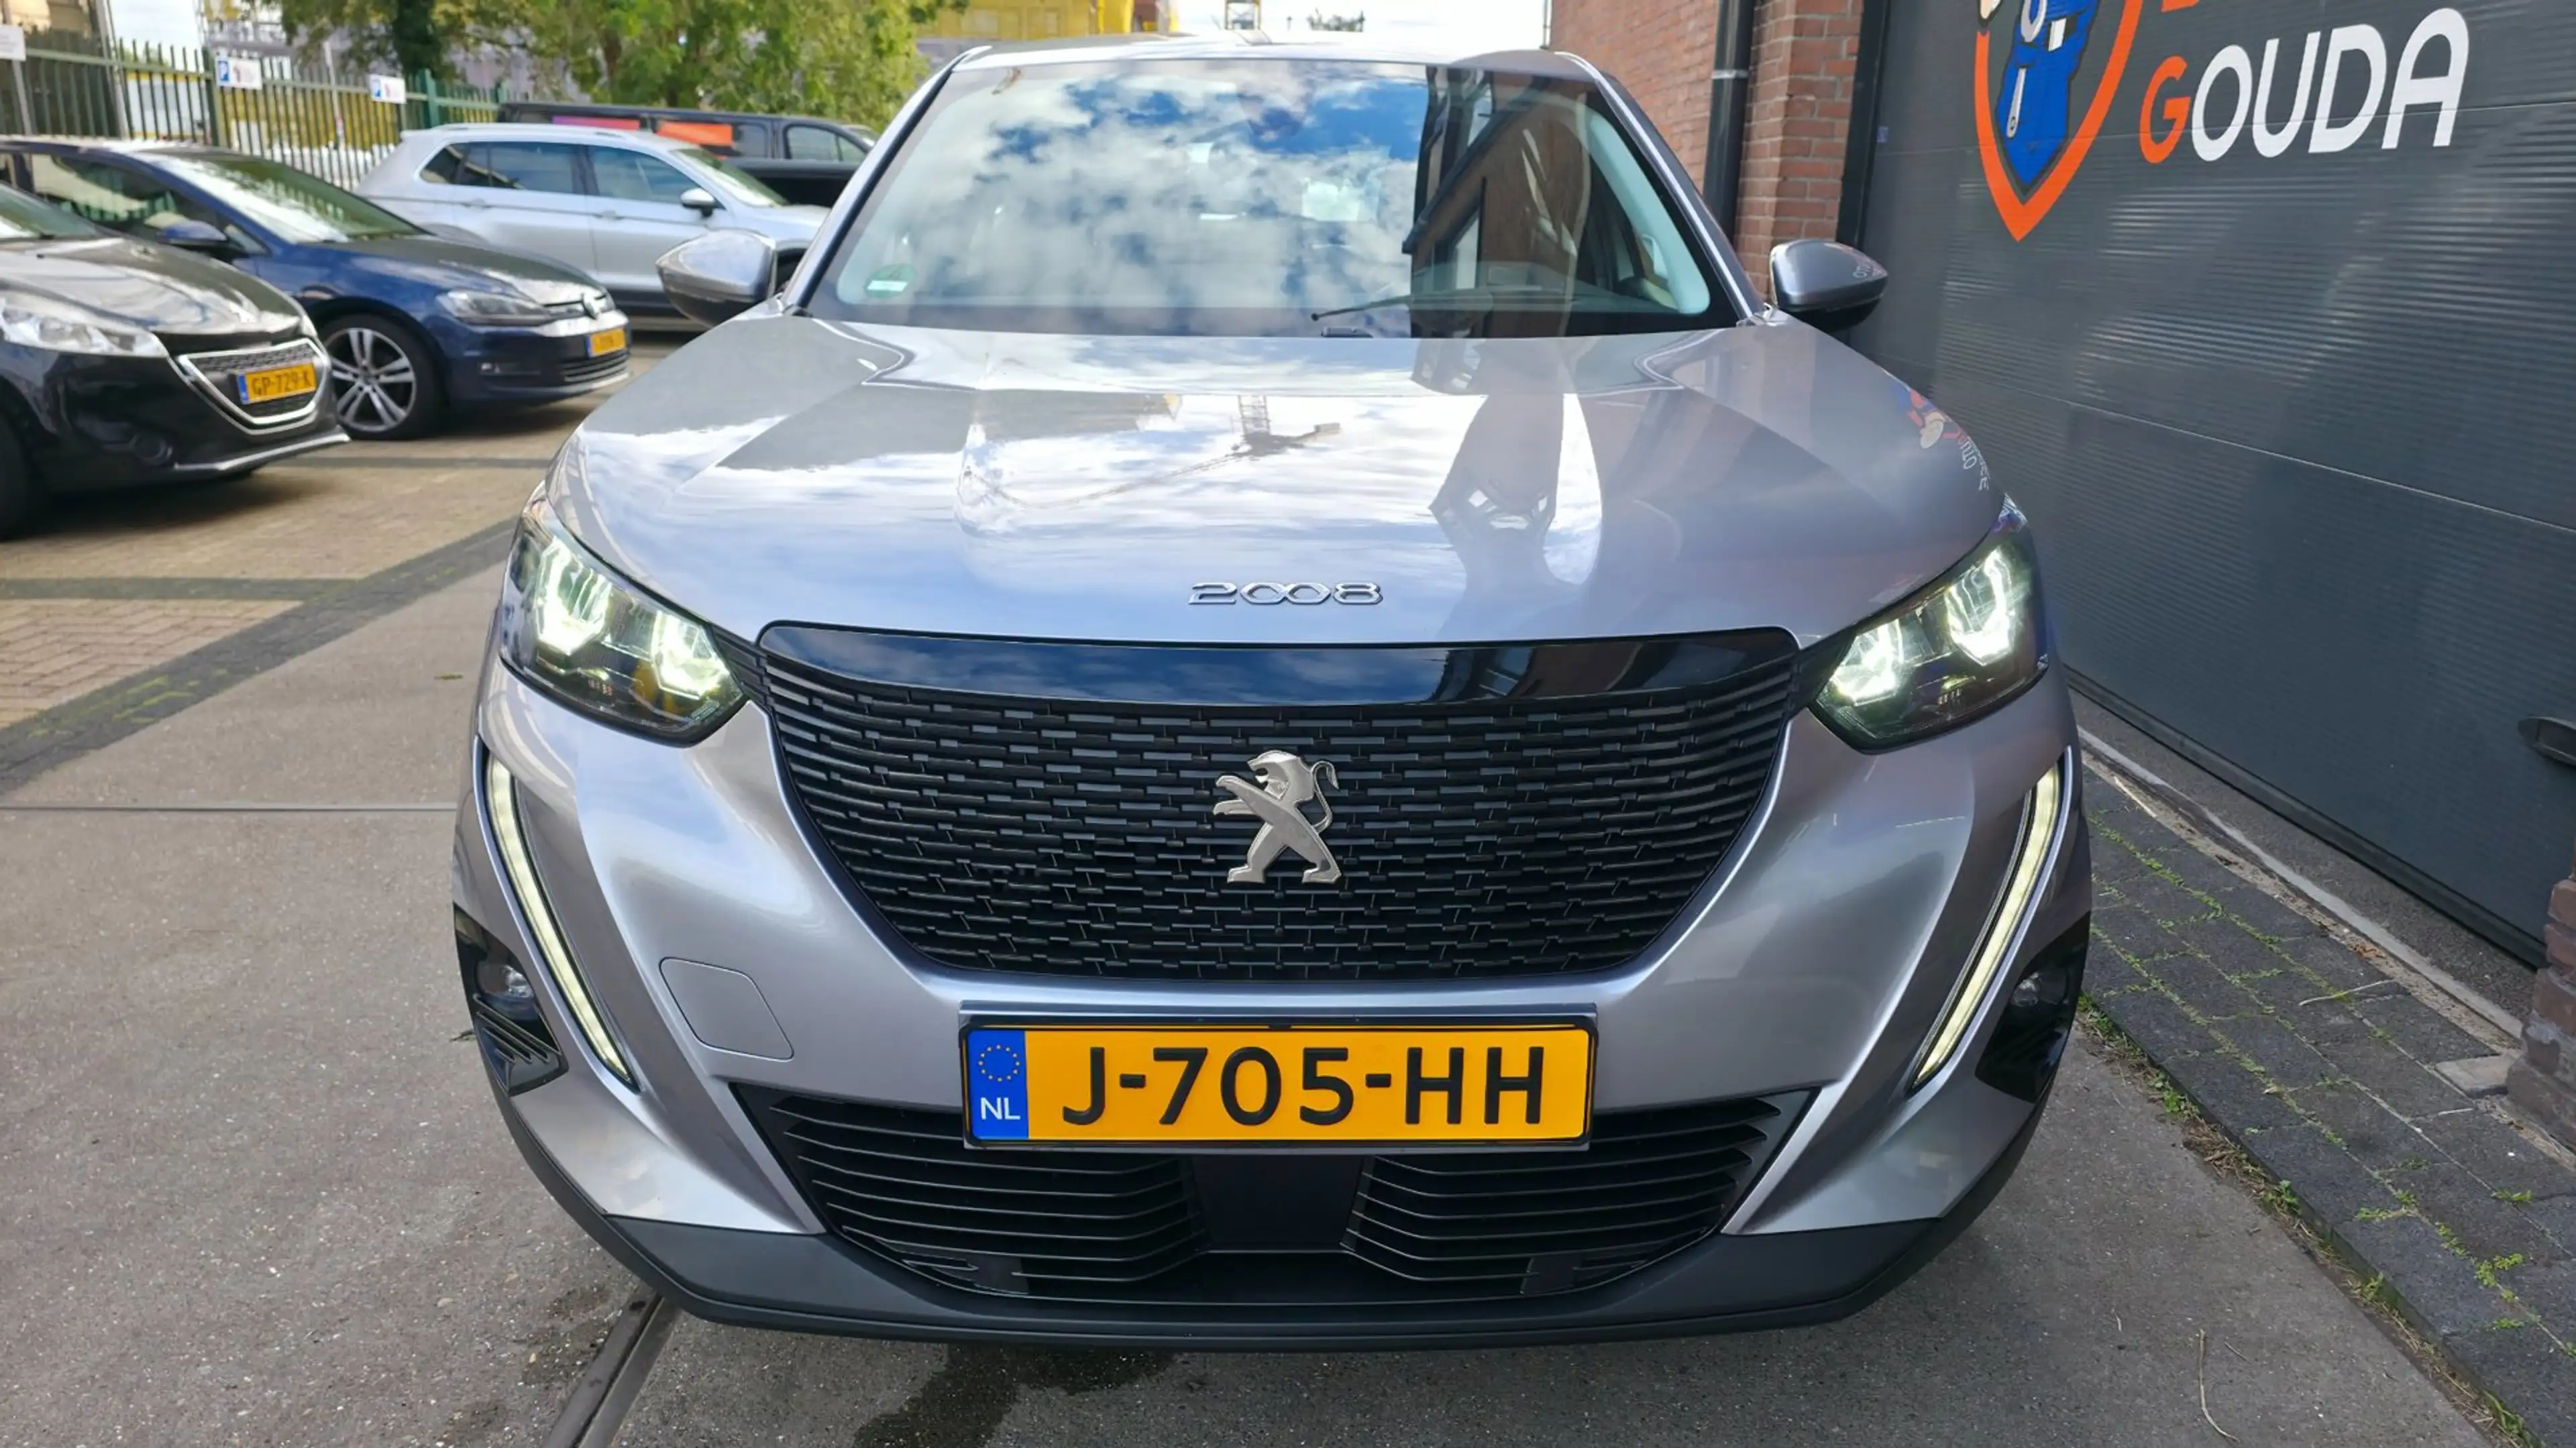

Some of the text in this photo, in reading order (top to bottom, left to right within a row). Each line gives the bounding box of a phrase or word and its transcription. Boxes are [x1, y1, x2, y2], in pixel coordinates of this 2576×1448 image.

[2140, 7, 2469, 164] GOUDA
[1188, 581, 1383, 605] 2008
[980, 1047, 1544, 1125] NL J-705-HH
